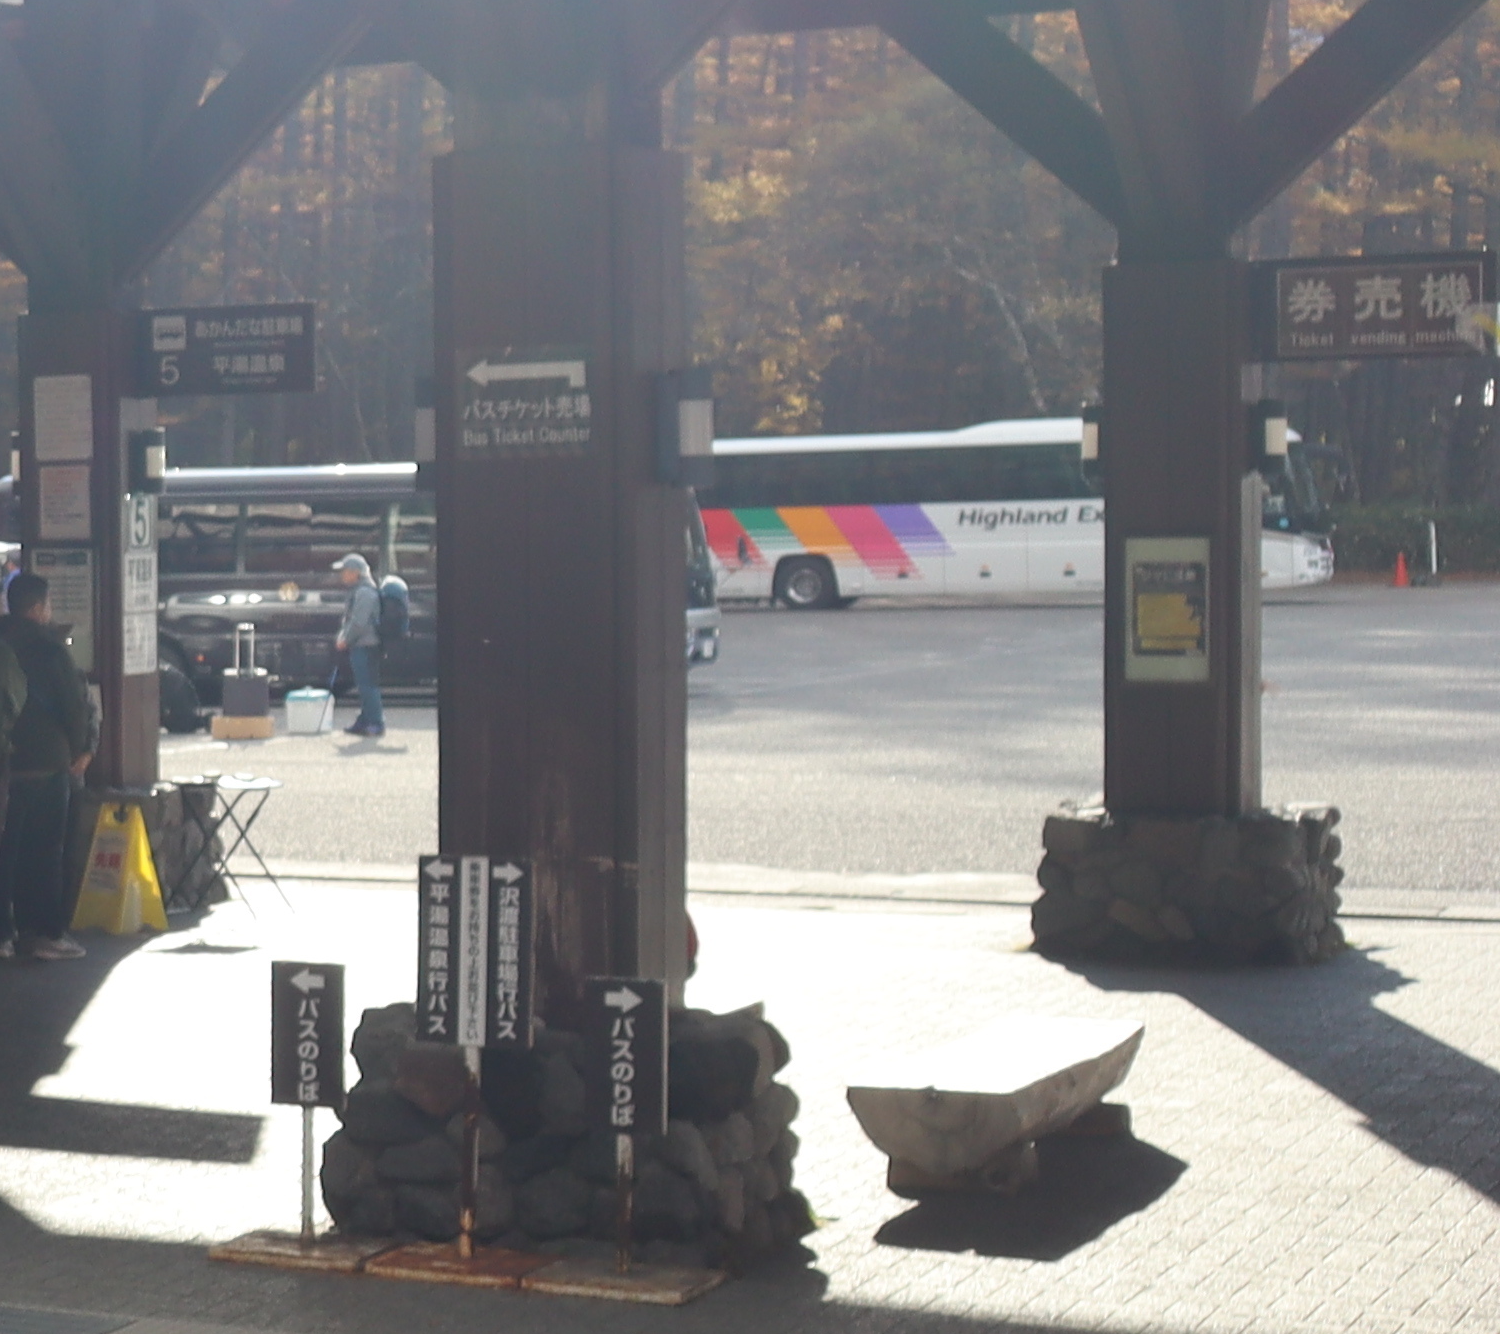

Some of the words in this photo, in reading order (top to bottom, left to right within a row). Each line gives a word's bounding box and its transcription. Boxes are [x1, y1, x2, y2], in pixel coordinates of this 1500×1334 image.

[1287, 271, 1473, 324] 券売機
[159, 354, 181, 386] 5
[462, 393, 592, 420] バスチケット売場
[462, 429, 489, 447] Bus
[493, 427, 535, 445] Ticket
[539, 426, 591, 443] Counter
[958, 506, 1069, 531] Highland
[427, 882, 451, 1035] 平湯温泉行バス
[496, 886, 521, 1040] 沢渡駐車場行バス
[297, 997, 320, 1103] バスのりば
[610, 1016, 636, 1127] バスのりば
